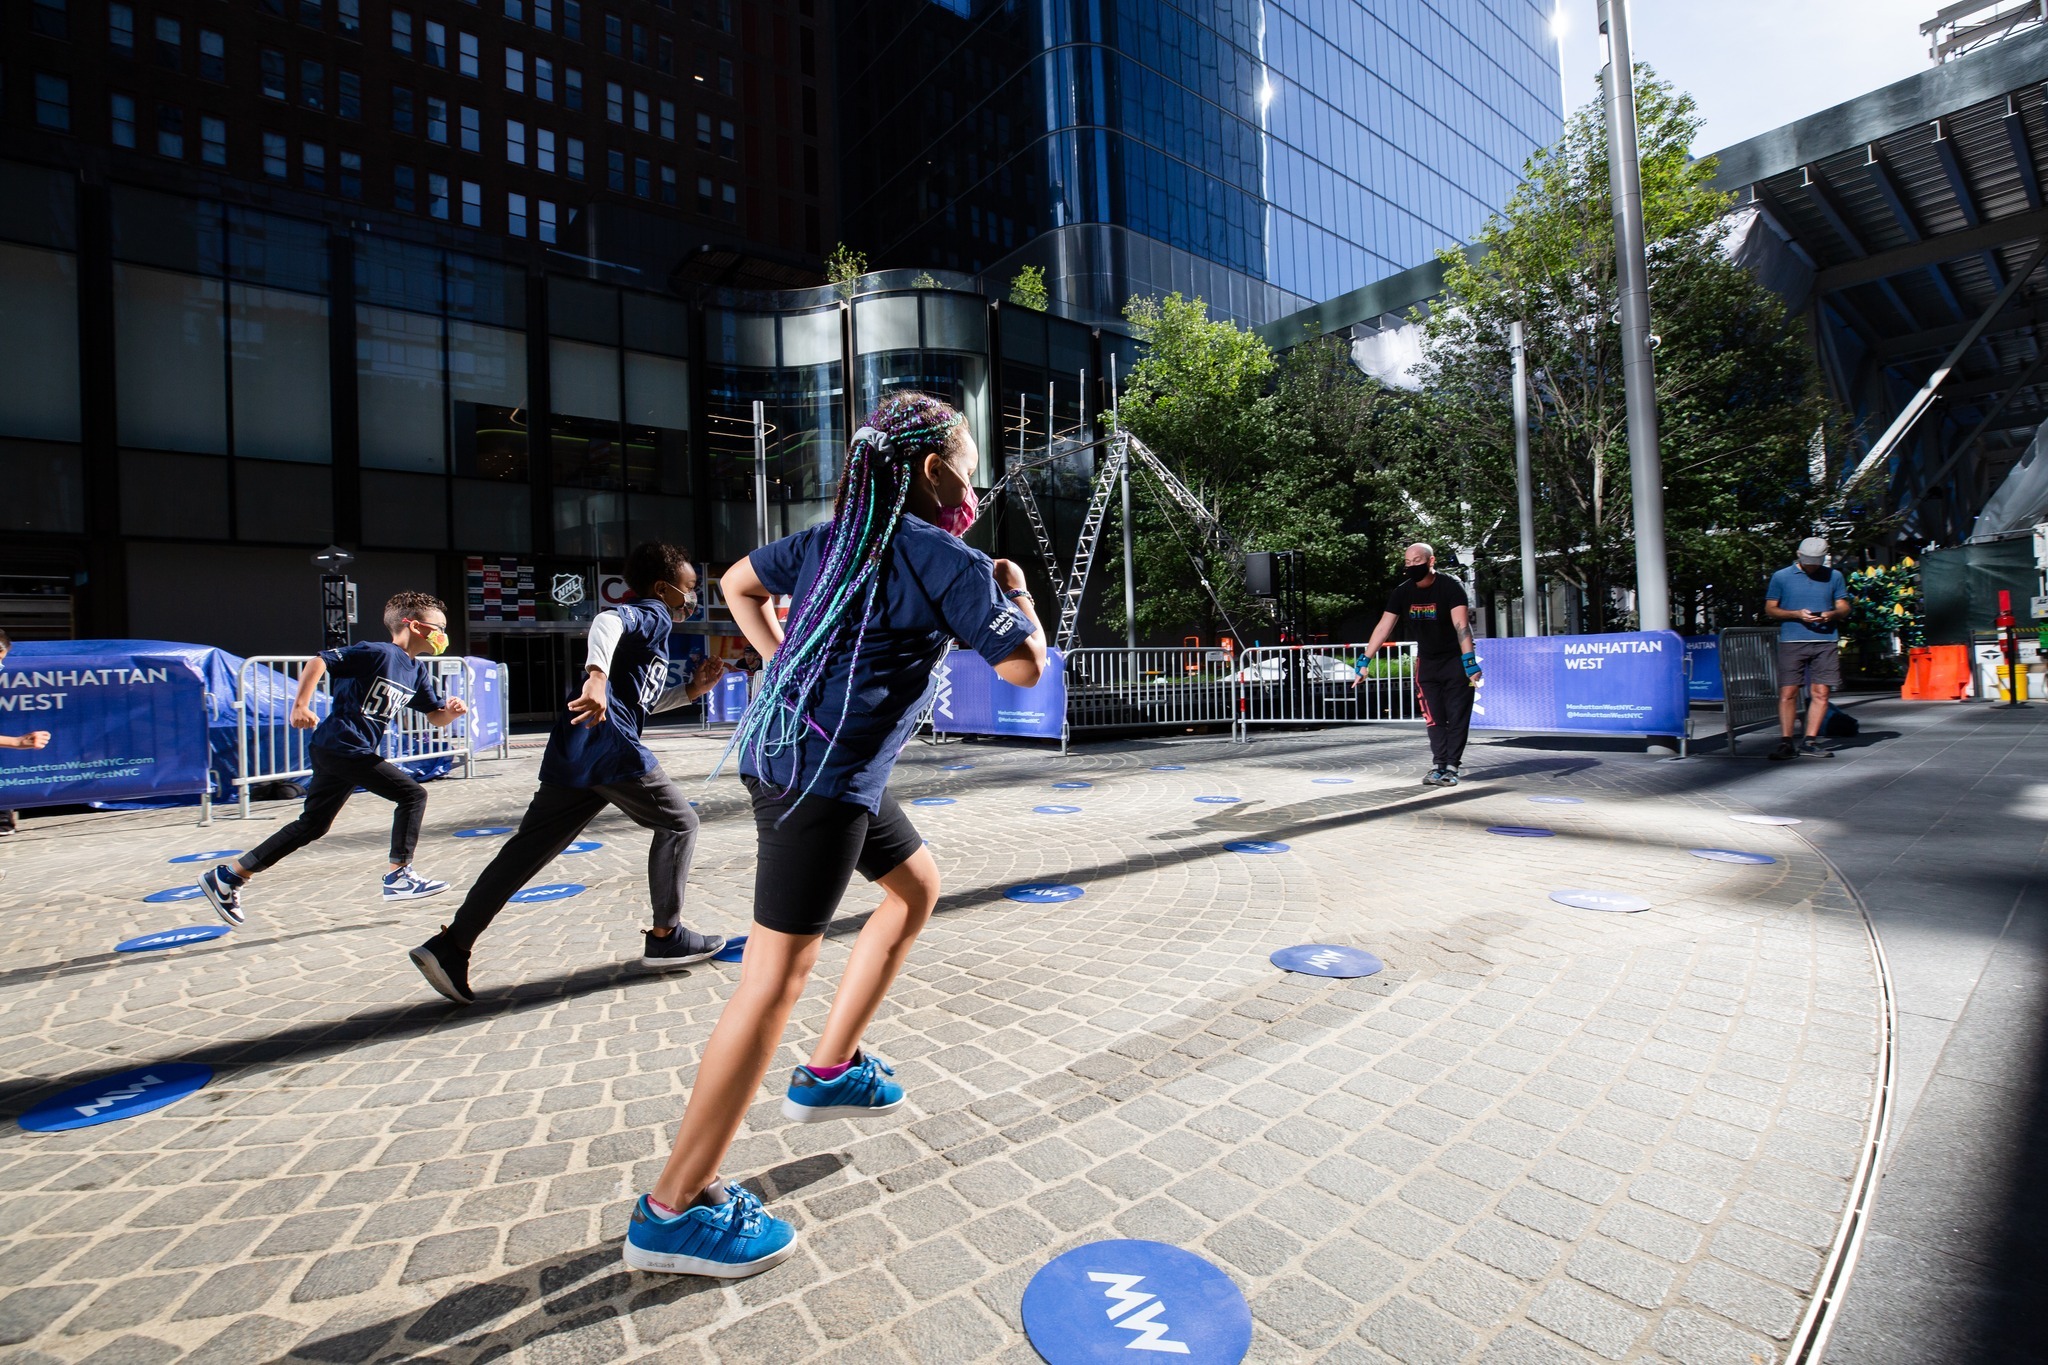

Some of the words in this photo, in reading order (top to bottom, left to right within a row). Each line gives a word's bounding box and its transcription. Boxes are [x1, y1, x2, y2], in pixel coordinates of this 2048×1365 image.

[557, 580, 579, 599] NHL
[1564, 640, 1662, 655] MANHATTAN
[1565, 658, 1604, 670] WEST
[1566, 703, 1652, 711] ManhattanWestNYC.com
[1567, 711, 1644, 719] @ManhattanWestNYC
[0, 757, 154, 774] anhattanWestNYC.com
[1087, 1272, 1191, 1354] MW
